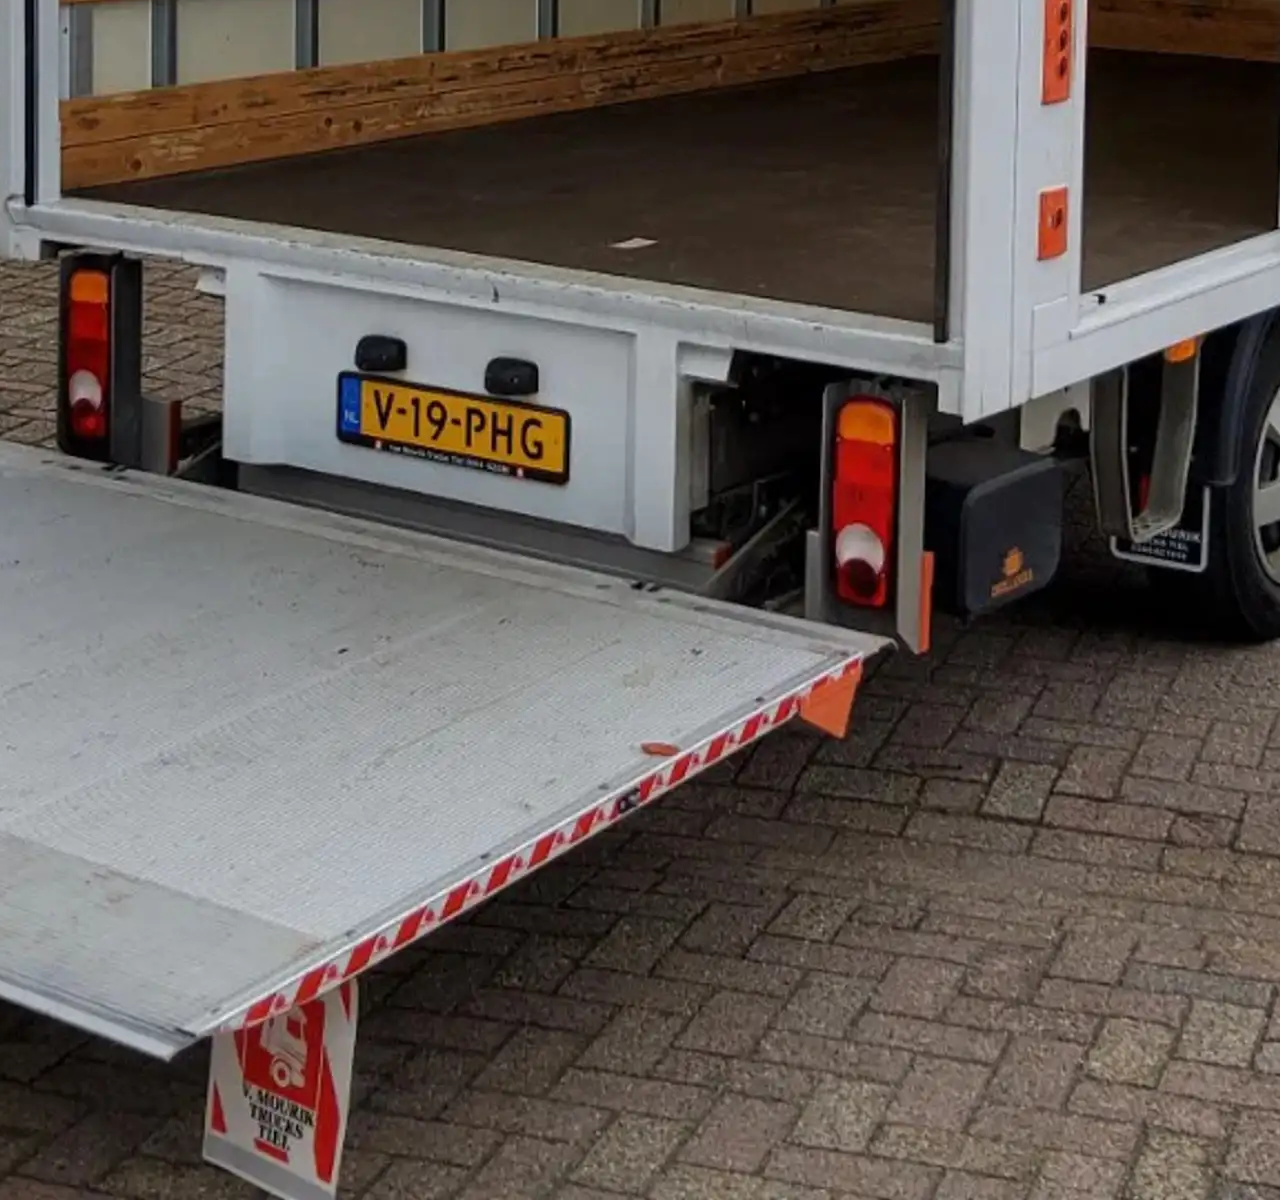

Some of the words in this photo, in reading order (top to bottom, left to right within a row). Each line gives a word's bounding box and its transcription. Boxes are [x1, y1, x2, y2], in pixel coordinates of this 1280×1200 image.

[344, 409, 359, 424] NL
[373, 389, 543, 460] V-19-PHG
[249, 1102, 304, 1139] TRUCKS
[258, 1089, 314, 1127] MOURIK
